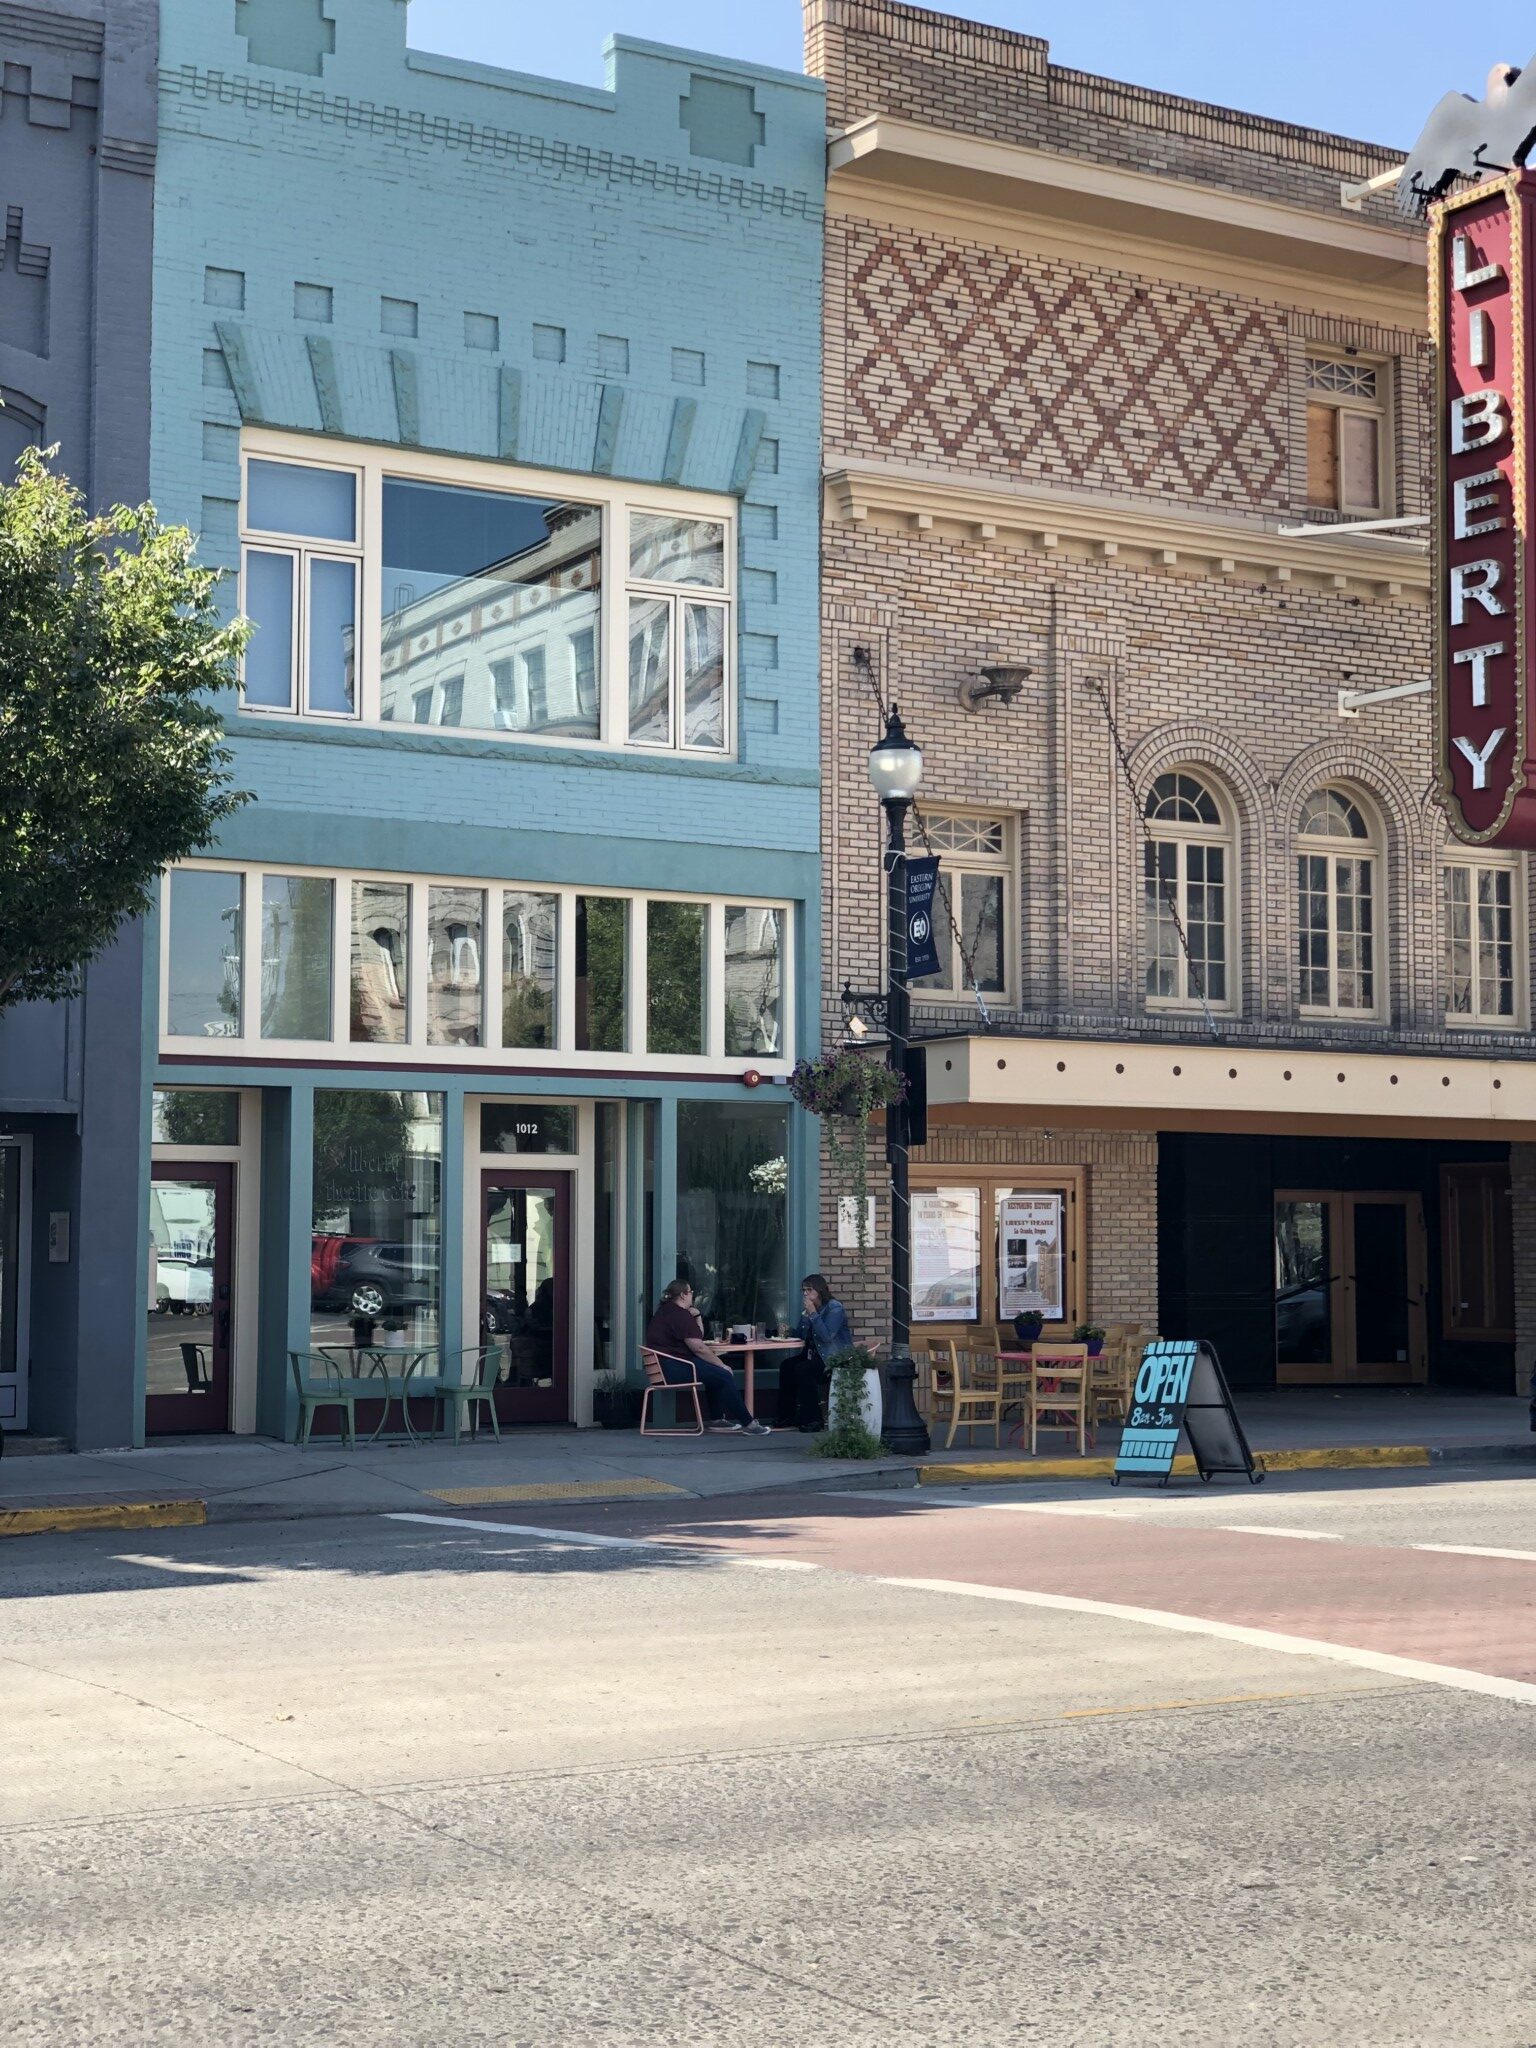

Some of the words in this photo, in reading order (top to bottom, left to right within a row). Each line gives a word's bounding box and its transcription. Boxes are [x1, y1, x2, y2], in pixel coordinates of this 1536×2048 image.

[1450, 233, 1508, 790] LIBERTY
[911, 872, 934, 884] EASTERN
[911, 882, 932, 894] OREGON
[516, 1123, 538, 1134] 1012
[1134, 1355, 1196, 1404] OPEN
